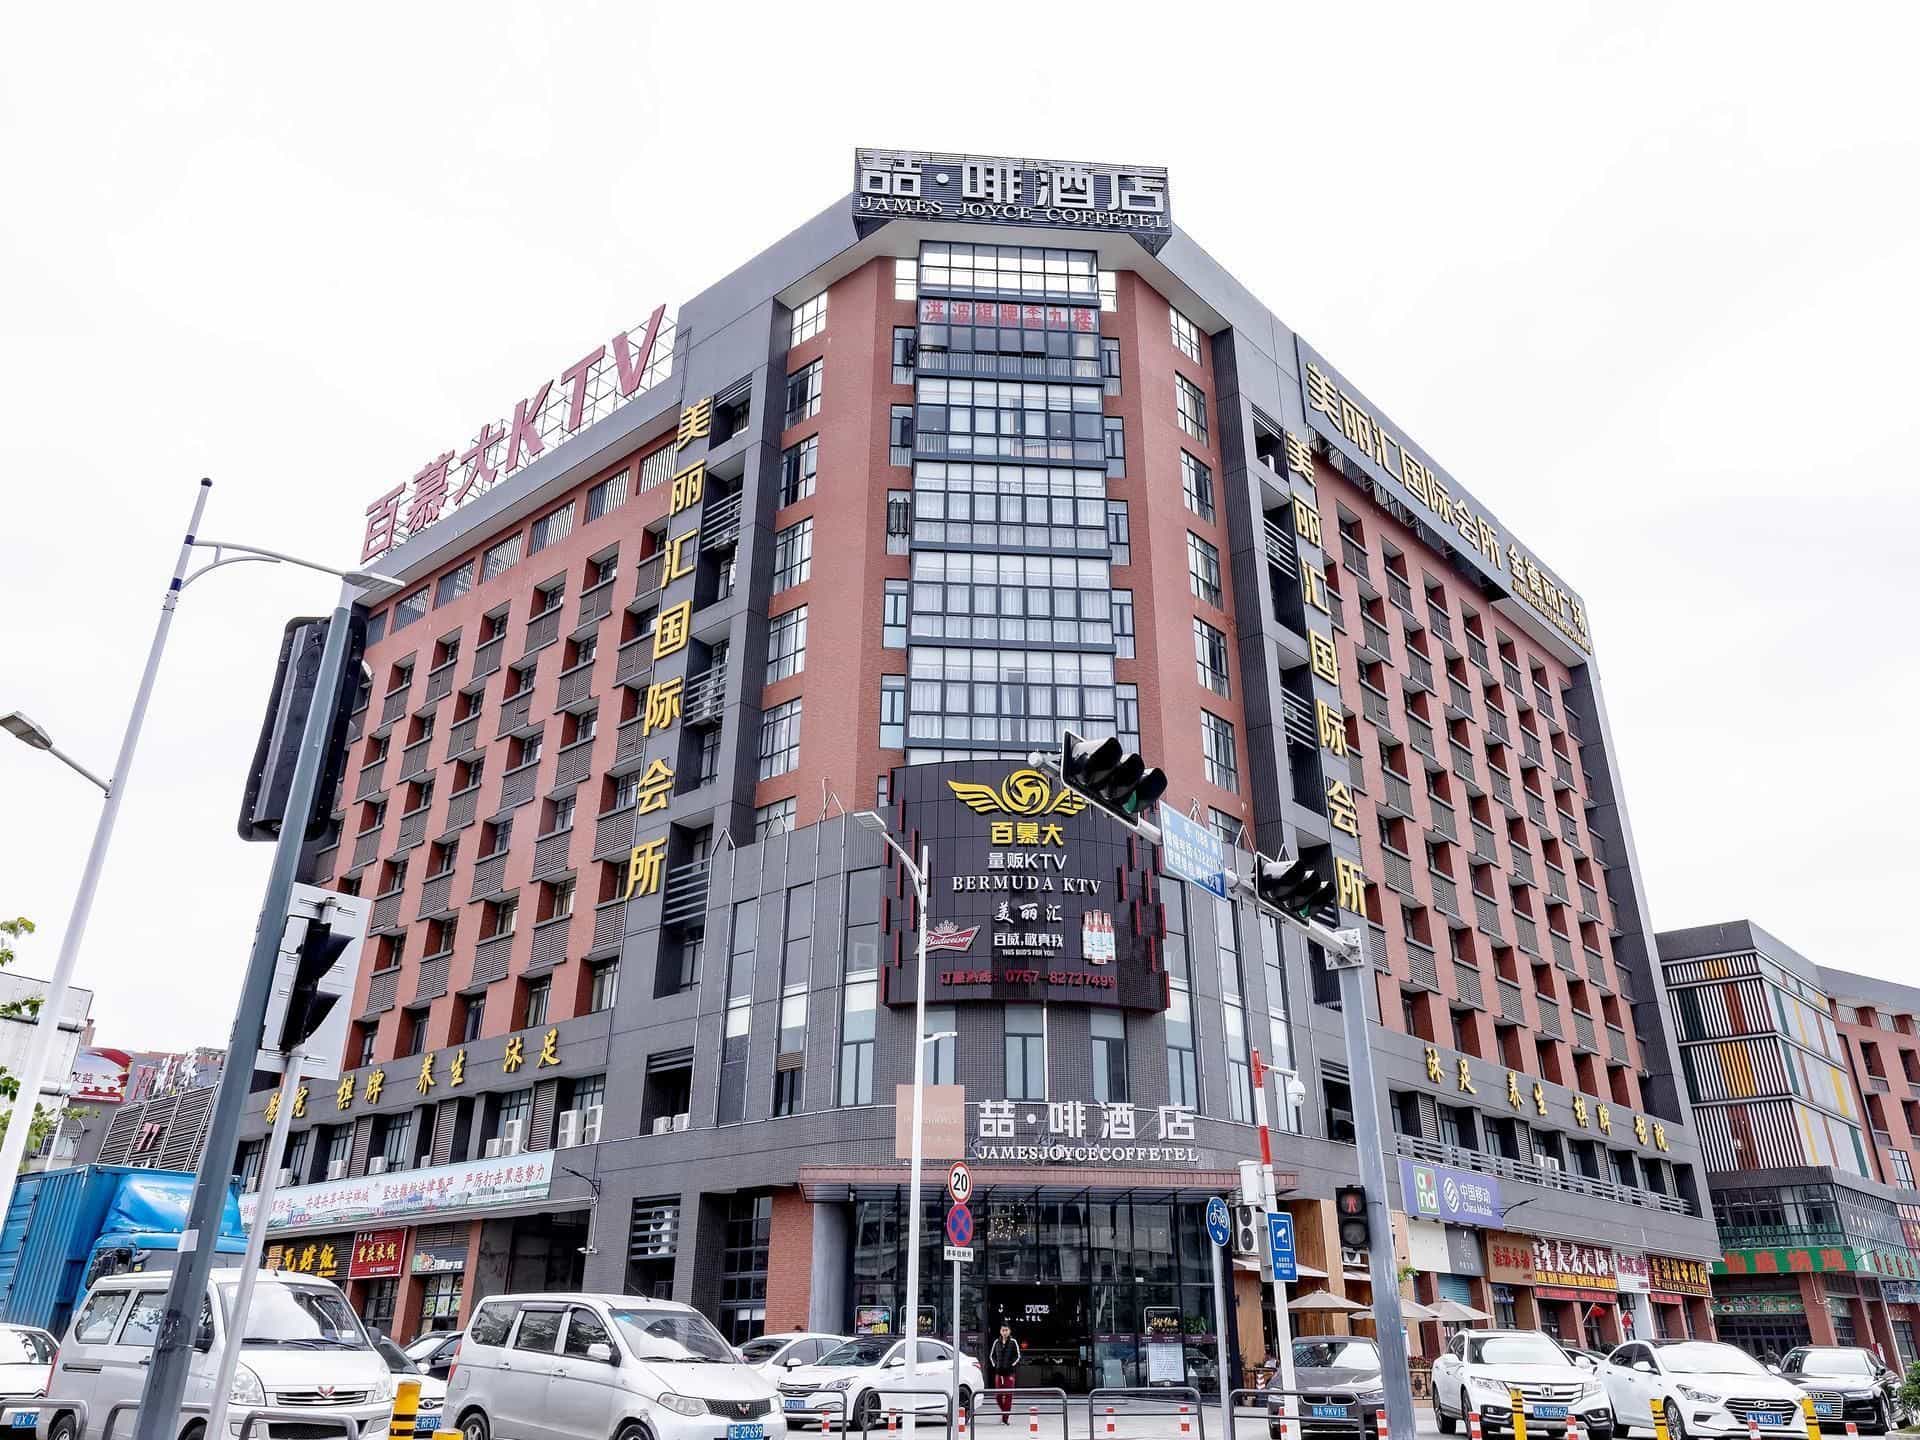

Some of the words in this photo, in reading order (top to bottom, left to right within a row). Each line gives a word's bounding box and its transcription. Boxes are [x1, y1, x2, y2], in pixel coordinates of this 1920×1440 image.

[861, 151, 1166, 213] 喆·啡酒店
[860, 197, 943, 214] JAMES
[955, 202, 1034, 220] JOYCE
[1046, 207, 1171, 229] COFFETEL
[1305, 362, 1502, 572] 美丽汇国际会所
[624, 397, 711, 902] 美丽汇国际会所
[1286, 430, 1367, 920] 美丽汇国际会所
[991, 822, 1064, 845] 百慕大
[988, 852, 1067, 872] 量贩KTV
[952, 876, 1055, 894] BERMUDA
[1063, 878, 1102, 895] KTV
[924, 934, 972, 949] Budweiser
[416, 1049, 466, 1095] 养生
[979, 1099, 1196, 1140] 喆·啡酒店
[953, 1172, 968, 1193] 20
[1460, 1183, 1491, 1204] 中国移动
